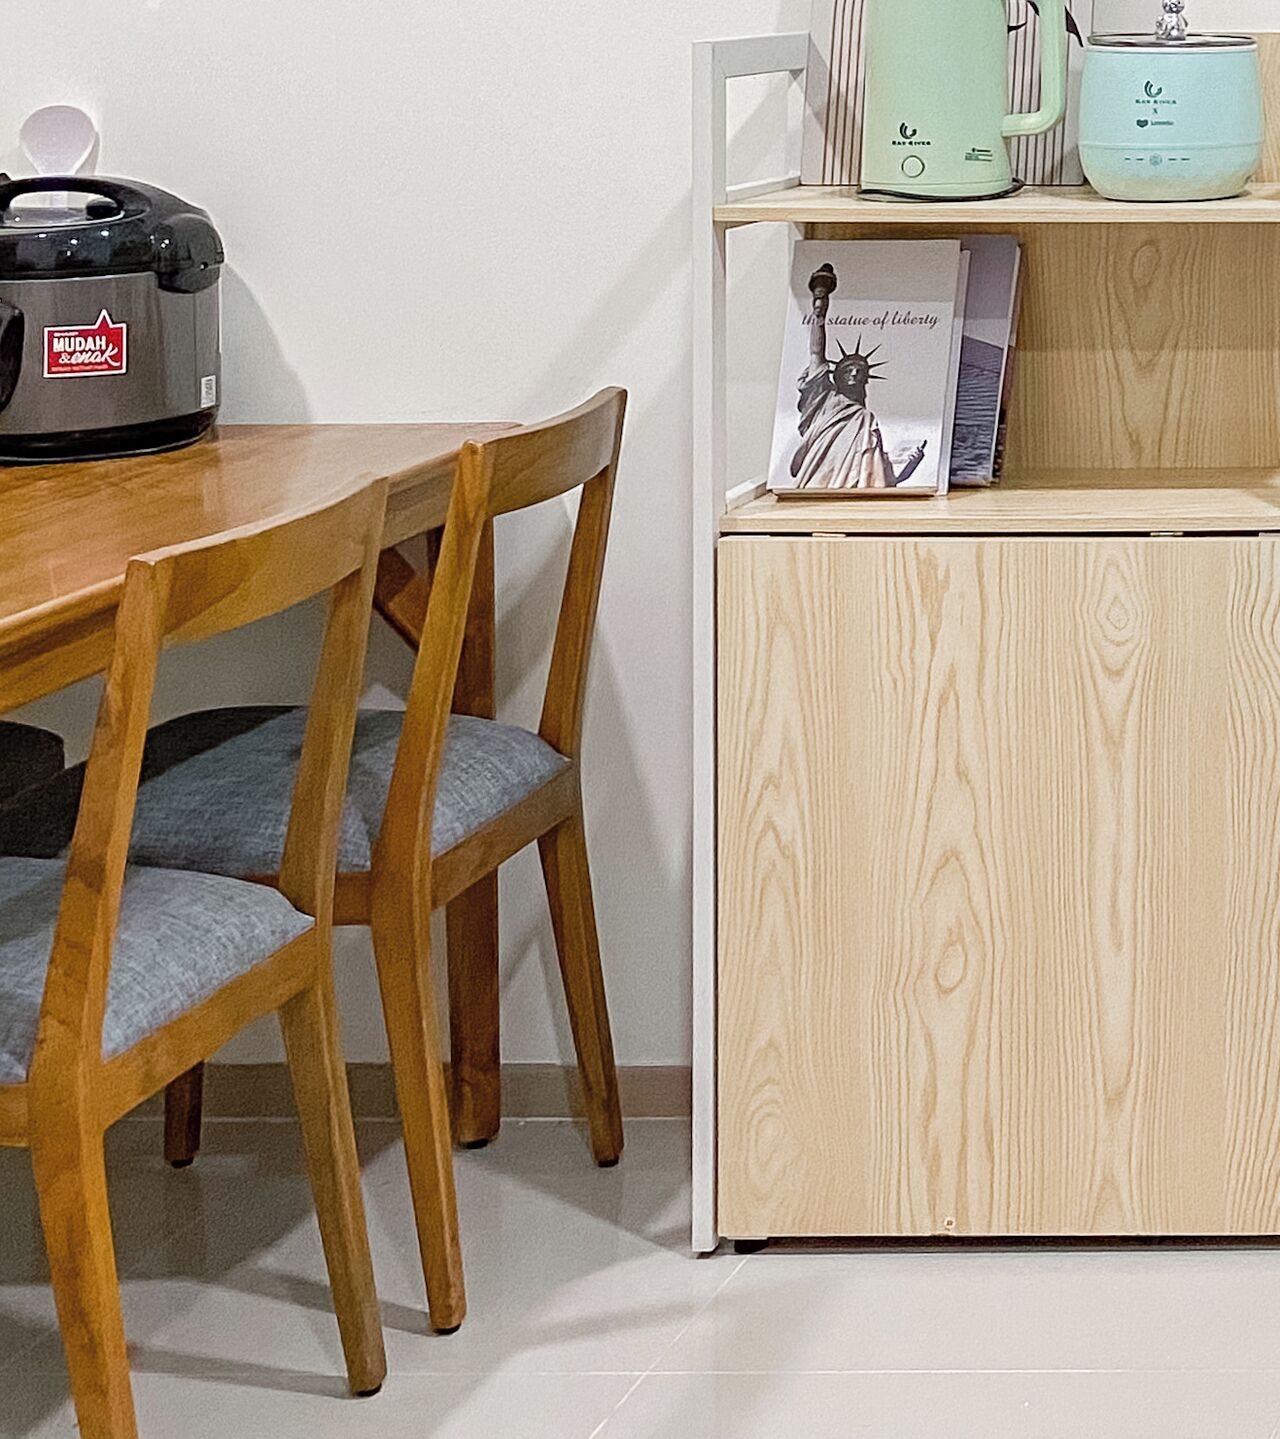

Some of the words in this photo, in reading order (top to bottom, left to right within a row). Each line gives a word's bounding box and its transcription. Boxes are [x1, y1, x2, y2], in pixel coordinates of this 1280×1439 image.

[826, 314, 870, 326] statue
[872, 310, 890, 330] of
[891, 310, 939, 330] liberty
[52, 335, 107, 353] MUDAH
